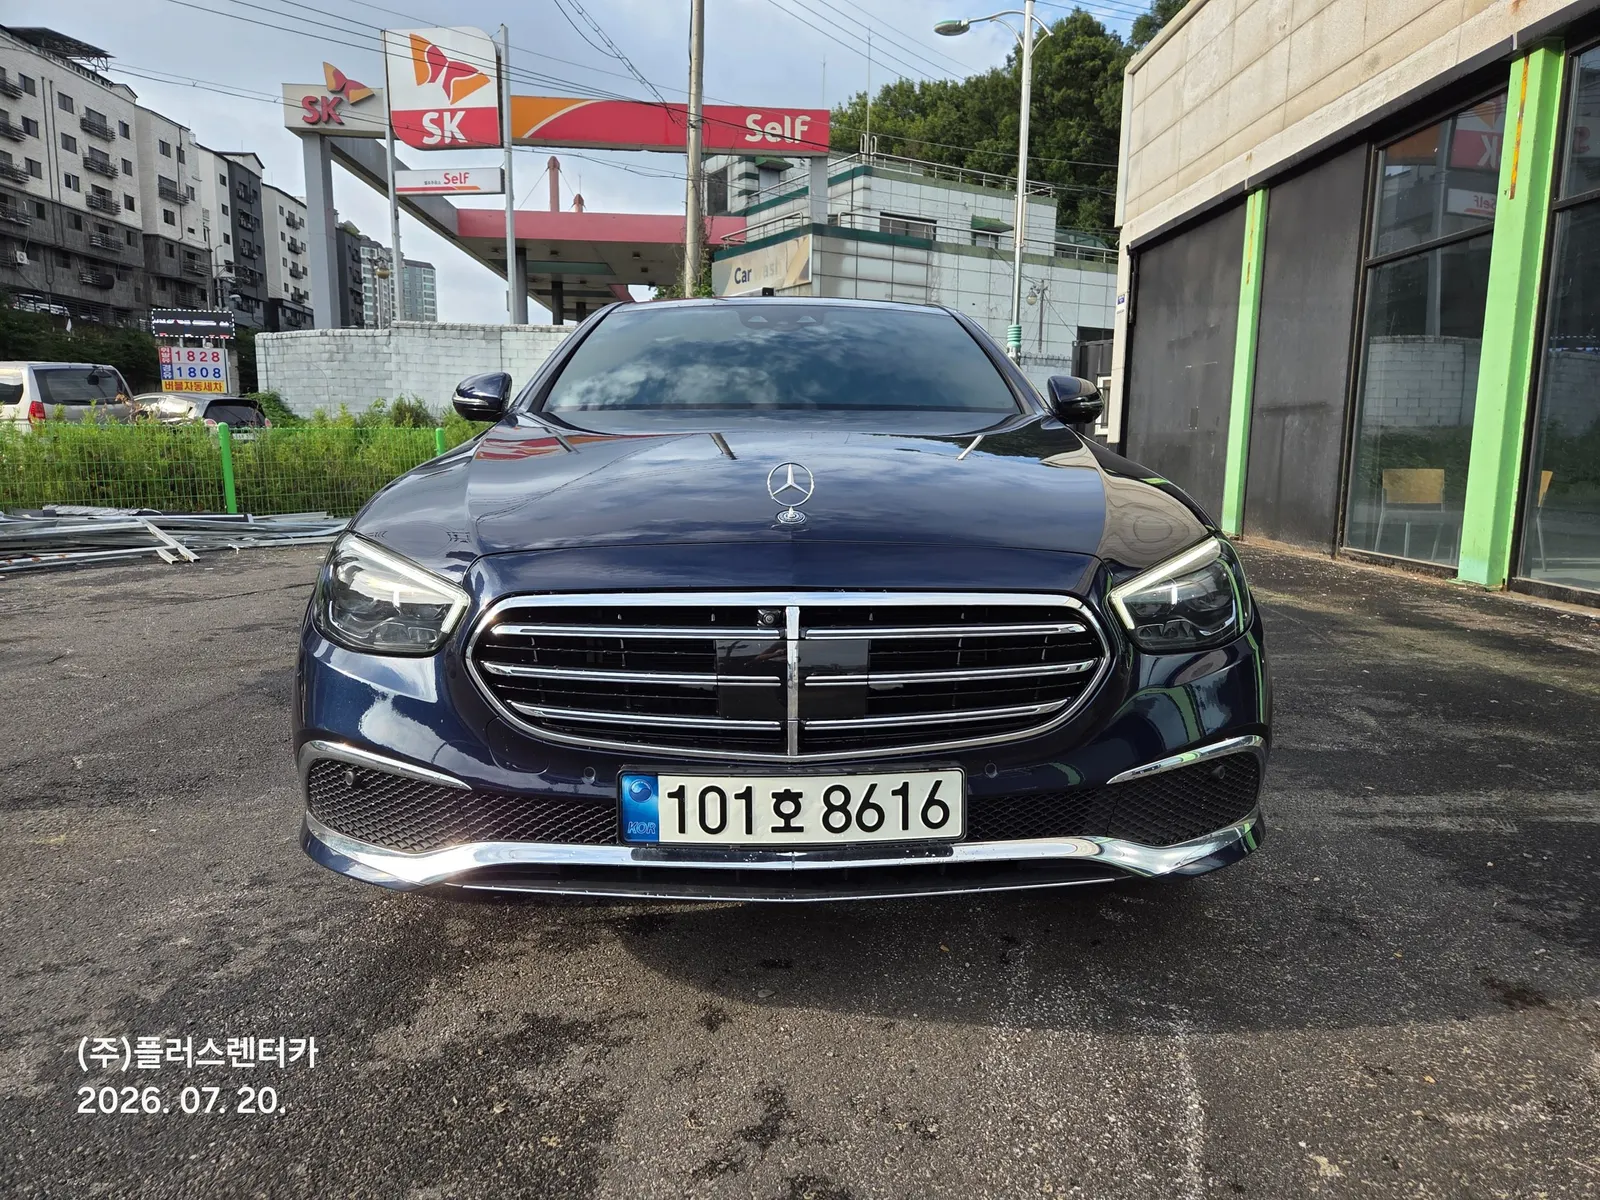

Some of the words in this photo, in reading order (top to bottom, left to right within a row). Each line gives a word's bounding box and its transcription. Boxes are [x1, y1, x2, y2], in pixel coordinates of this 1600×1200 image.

[301, 95, 345, 125] SK
[422, 110, 468, 145] SK
[745, 113, 811, 144] Self
[443, 171, 470, 185] Self
[734, 267, 752, 285] Car
[175, 350, 220, 362] 1828
[176, 366, 221, 378] 1808
[164, 381, 222, 392] 버블자동세차
[821, 779, 950, 834] 8616
[627, 821, 656, 835] KOR
